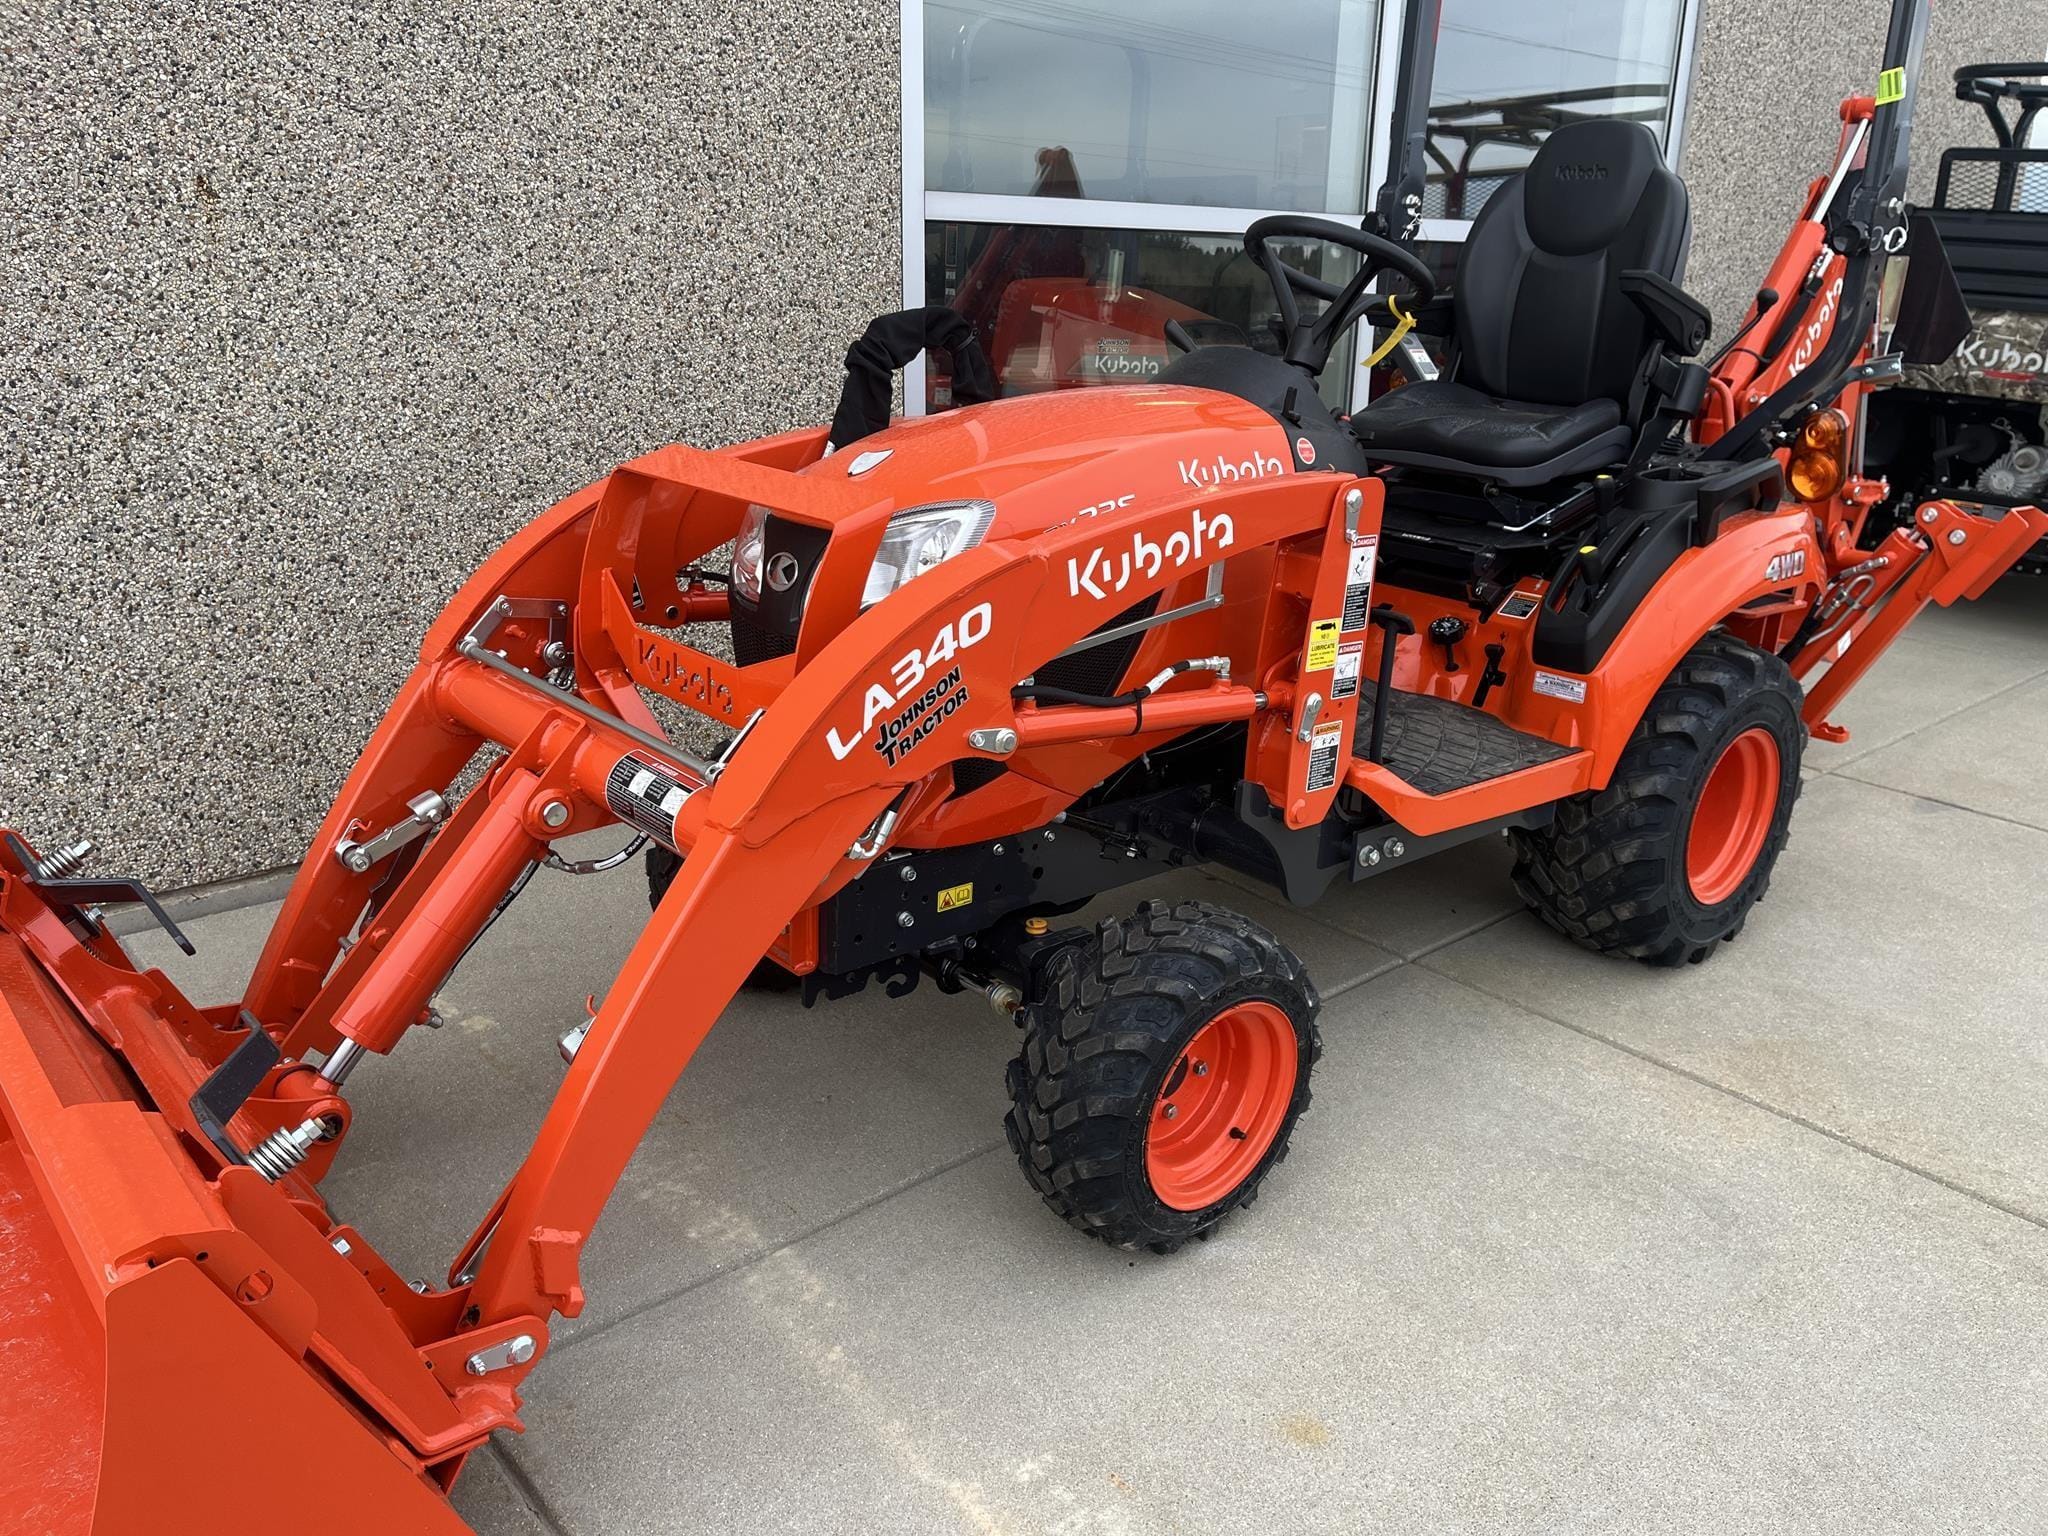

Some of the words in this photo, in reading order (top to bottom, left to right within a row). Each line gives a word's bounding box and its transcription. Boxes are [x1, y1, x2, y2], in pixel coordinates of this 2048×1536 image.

[1095, 355, 1159, 375] Kubota
[1788, 277, 1844, 378] Kubota
[1178, 450, 1284, 488] Kubota
[1067, 508, 1235, 600] Kubota
[1764, 550, 1806, 583] 4WD
[638, 638, 733, 714] Kubota
[826, 602, 992, 761] LA340
[1311, 642, 1336, 652] LUBRICATE
[875, 665, 962, 752] JOHNSON
[881, 685, 970, 769] TRACTOR
